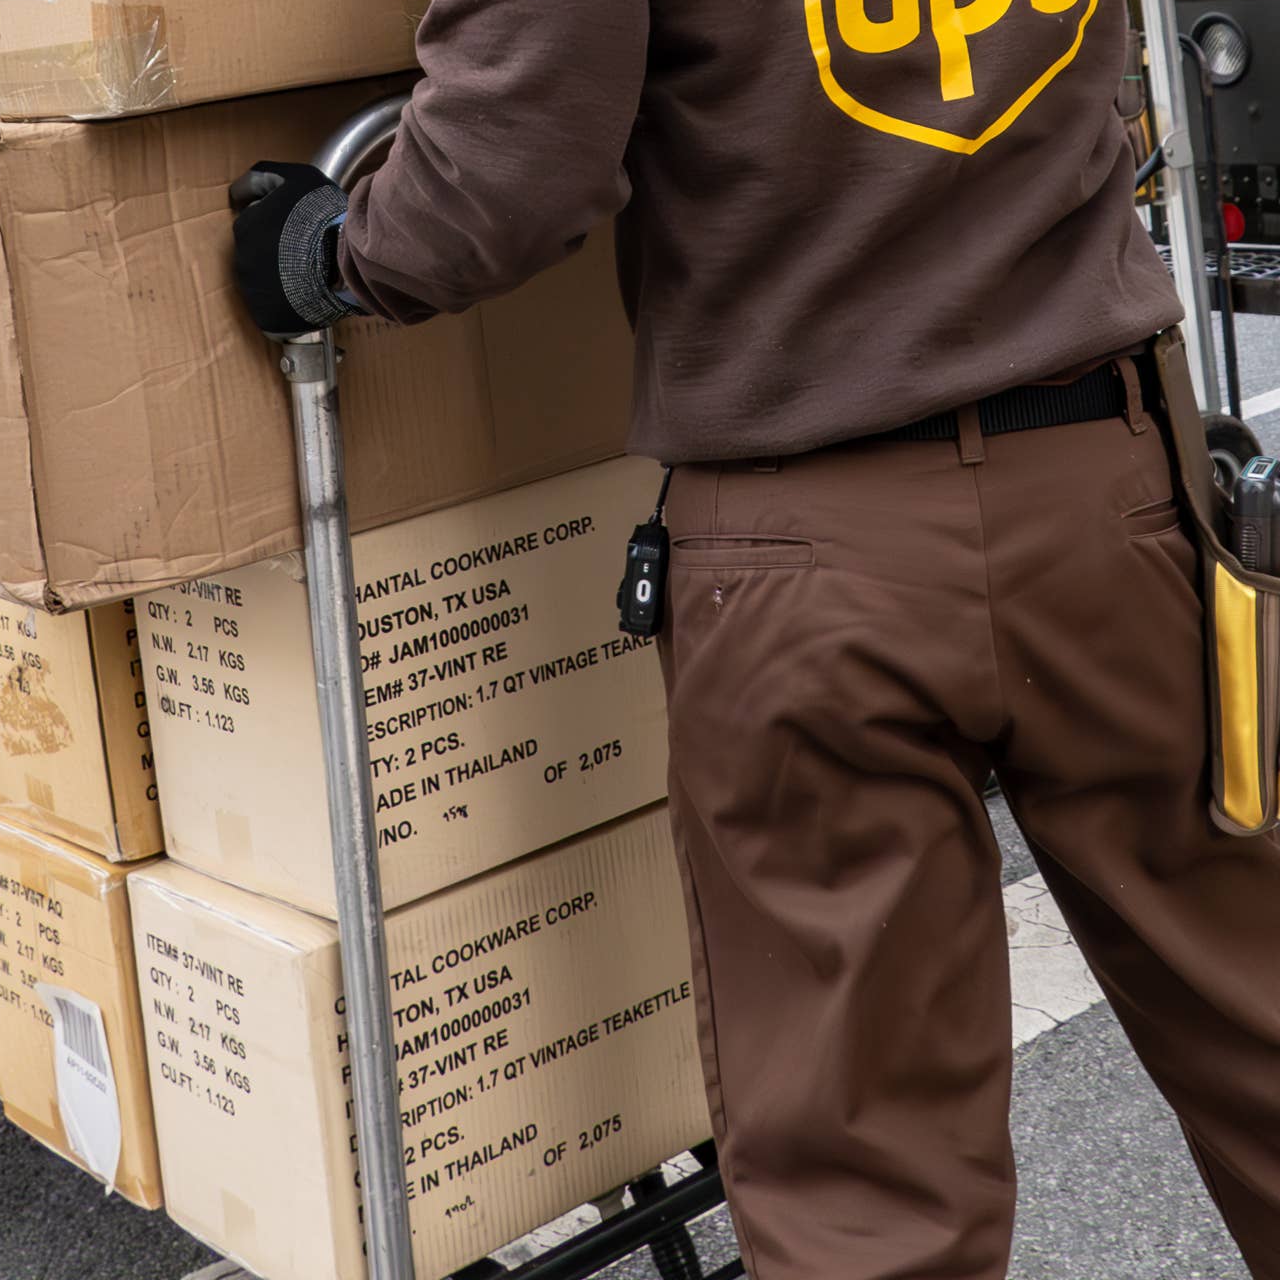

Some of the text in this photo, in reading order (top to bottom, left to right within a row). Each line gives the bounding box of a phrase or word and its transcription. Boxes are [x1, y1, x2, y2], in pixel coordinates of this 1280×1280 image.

[355, 516, 596, 605] HANTAL COOKWARE CORP.
[225, 586, 243, 607] RE
[357, 579, 511, 642] OUSTON, TX USA
[185, 610, 193, 627] 2
[214, 616, 239, 638] PCS
[360, 604, 530, 673] O# JAM1000000031
[21, 650, 42, 670] KGS
[152, 632, 177, 654] N.W.
[187, 642, 209, 662] 2.17
[219, 649, 245, 671] KGS
[365, 642, 509, 708] EM# 37-VINT RE
[156, 665, 181, 686] G.W.
[192, 675, 215, 695] 3.56
[223, 683, 250, 705] KGS
[366, 693, 474, 743] ESCRIPTION:
[476, 681, 499, 703] 1.7
[503, 672, 525, 694] QT
[529, 648, 599, 685] VINTAGE
[205, 710, 235, 733] 1.123
[370, 732, 465, 778] TY: 2 PCS.
[376, 739, 538, 813] ADE IN THAILAND
[378, 821, 418, 848] /NO.
[544, 761, 568, 784] OF
[579, 739, 622, 771] 2,075
[10, 878, 45, 909] 37-VINT
[47, 898, 64, 919] AQ
[16, 911, 22, 927] 2
[38, 922, 61, 945] PCS
[431, 915, 542, 973] COOKWARE
[545, 892, 598, 926] CORP.
[17, 940, 35, 961] 2.17
[41, 952, 65, 977] KGS
[146, 933, 244, 997] ITEM# 37-VINT RE
[187, 985, 195, 1003] 2
[216, 999, 240, 1026] PCS
[444, 982, 470, 1007] TX
[473, 965, 513, 994] USA
[154, 998, 178, 1024] N.W.
[220, 1032, 247, 1060] KGS
[476, 1069, 499, 1093] 1.7
[503, 1056, 526, 1081] QT
[529, 1024, 600, 1069] VINTAGE
[602, 981, 691, 1036] TEAKETTLE
[157, 1030, 251, 1094] G.W. 3.56 KGS
[408, 1029, 509, 1090] 37-VINT RE
[206, 1087, 235, 1117] 1.123
[405, 1126, 465, 1166] 2 PCS.
[421, 1171, 440, 1194] IN
[445, 1123, 538, 1181] THAILAND
[543, 1114, 622, 1167] OF 2,075
